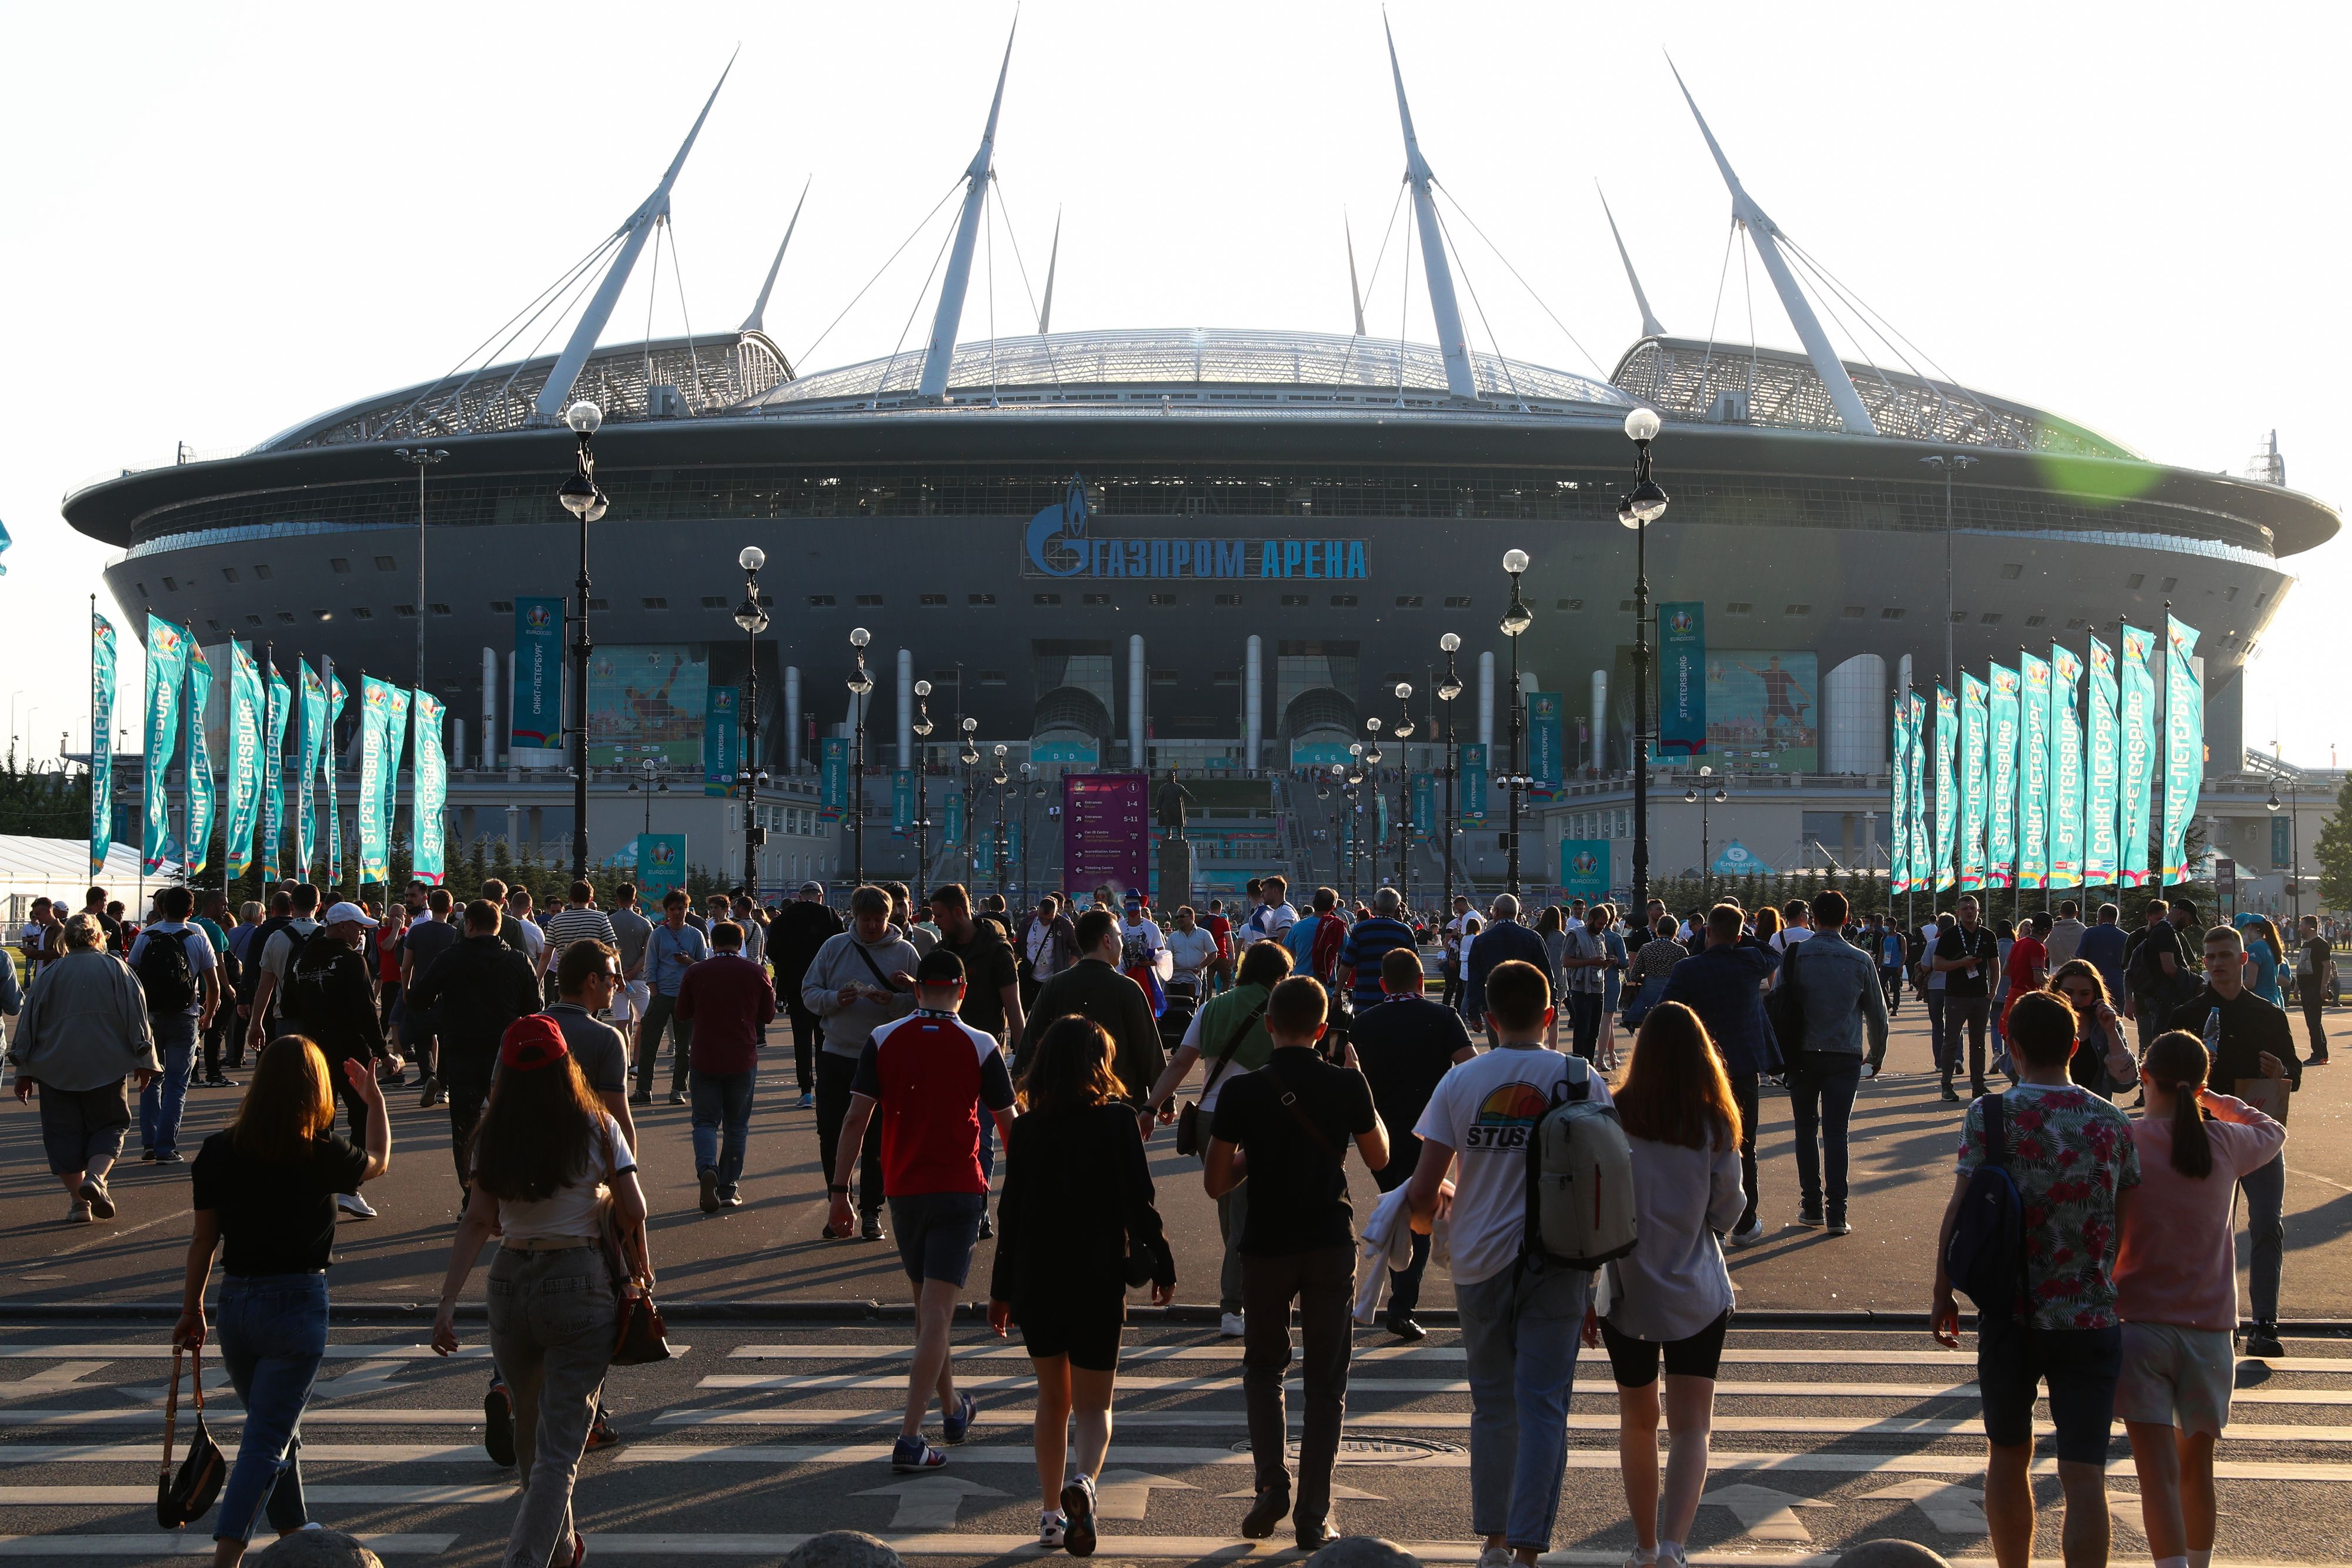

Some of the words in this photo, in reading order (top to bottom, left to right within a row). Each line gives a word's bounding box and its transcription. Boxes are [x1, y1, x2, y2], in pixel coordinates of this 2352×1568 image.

[1092, 539, 1245, 578] ГАЗПРОМ
[1261, 540, 1366, 579] АРЕНА
[533, 643, 543, 715] САНКТ-ПЕТЕРБУРГ
[1680, 708, 1687, 718] ST
[237, 698, 255, 810] PETERSBURG
[361, 728, 379, 823] PETERSBURG
[423, 740, 437, 829] PETERSBURG
[1938, 734, 1950, 832] PETERSBURG
[1967, 716, 1983, 862] САНКТ-ПЕТЕРБУРГ
[1995, 720, 2012, 823] PETERSBURG
[2026, 700, 2043, 857] САНКТ-ПЕТЕРБУРГ
[2060, 707, 2077, 818] PETERSBURG
[2093, 683, 2112, 854] САНКТ-ПЕТЕРБУРГ
[2127, 690, 2146, 810] PETERSBURG
[2168, 664, 2190, 848] САНКТ-ПЕТЕРБУРГ
[234, 814, 248, 834] ST
[362, 827, 376, 844] ST
[423, 831, 436, 849] ST
[1937, 834, 1948, 853] ST
[1995, 826, 2009, 846] ST
[2059, 822, 2074, 843] ST
[2127, 814, 2136, 838] ST
